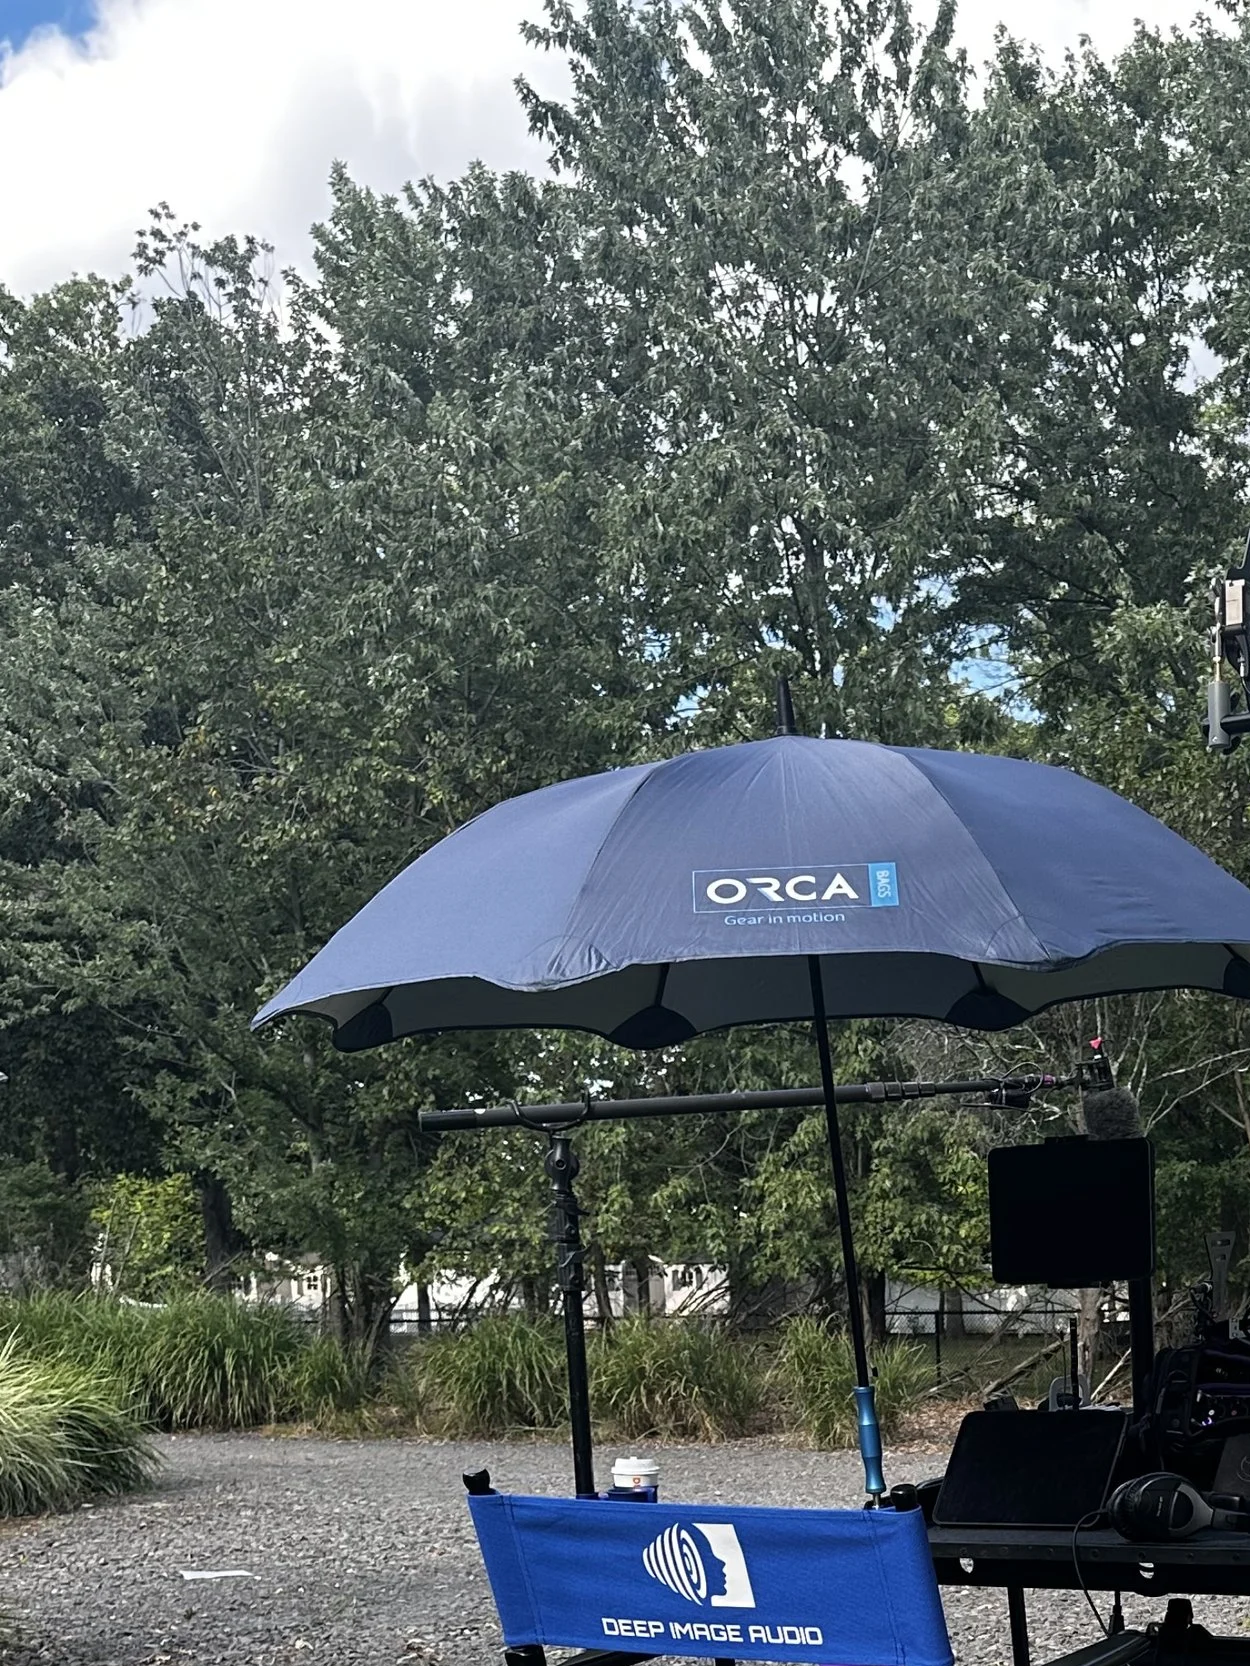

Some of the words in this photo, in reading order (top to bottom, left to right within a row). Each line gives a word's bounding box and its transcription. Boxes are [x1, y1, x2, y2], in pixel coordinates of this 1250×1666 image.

[706, 872, 859, 905] ORCA
[875, 869, 892, 898] BAGS
[723, 915, 764, 926] Gear
[768, 914, 783, 924] in
[786, 912, 846, 924] motion
[601, 1617, 665, 1638] DEEP
[669, 1621, 744, 1643] IMAGE
[748, 1625, 824, 1646] AUDIO
